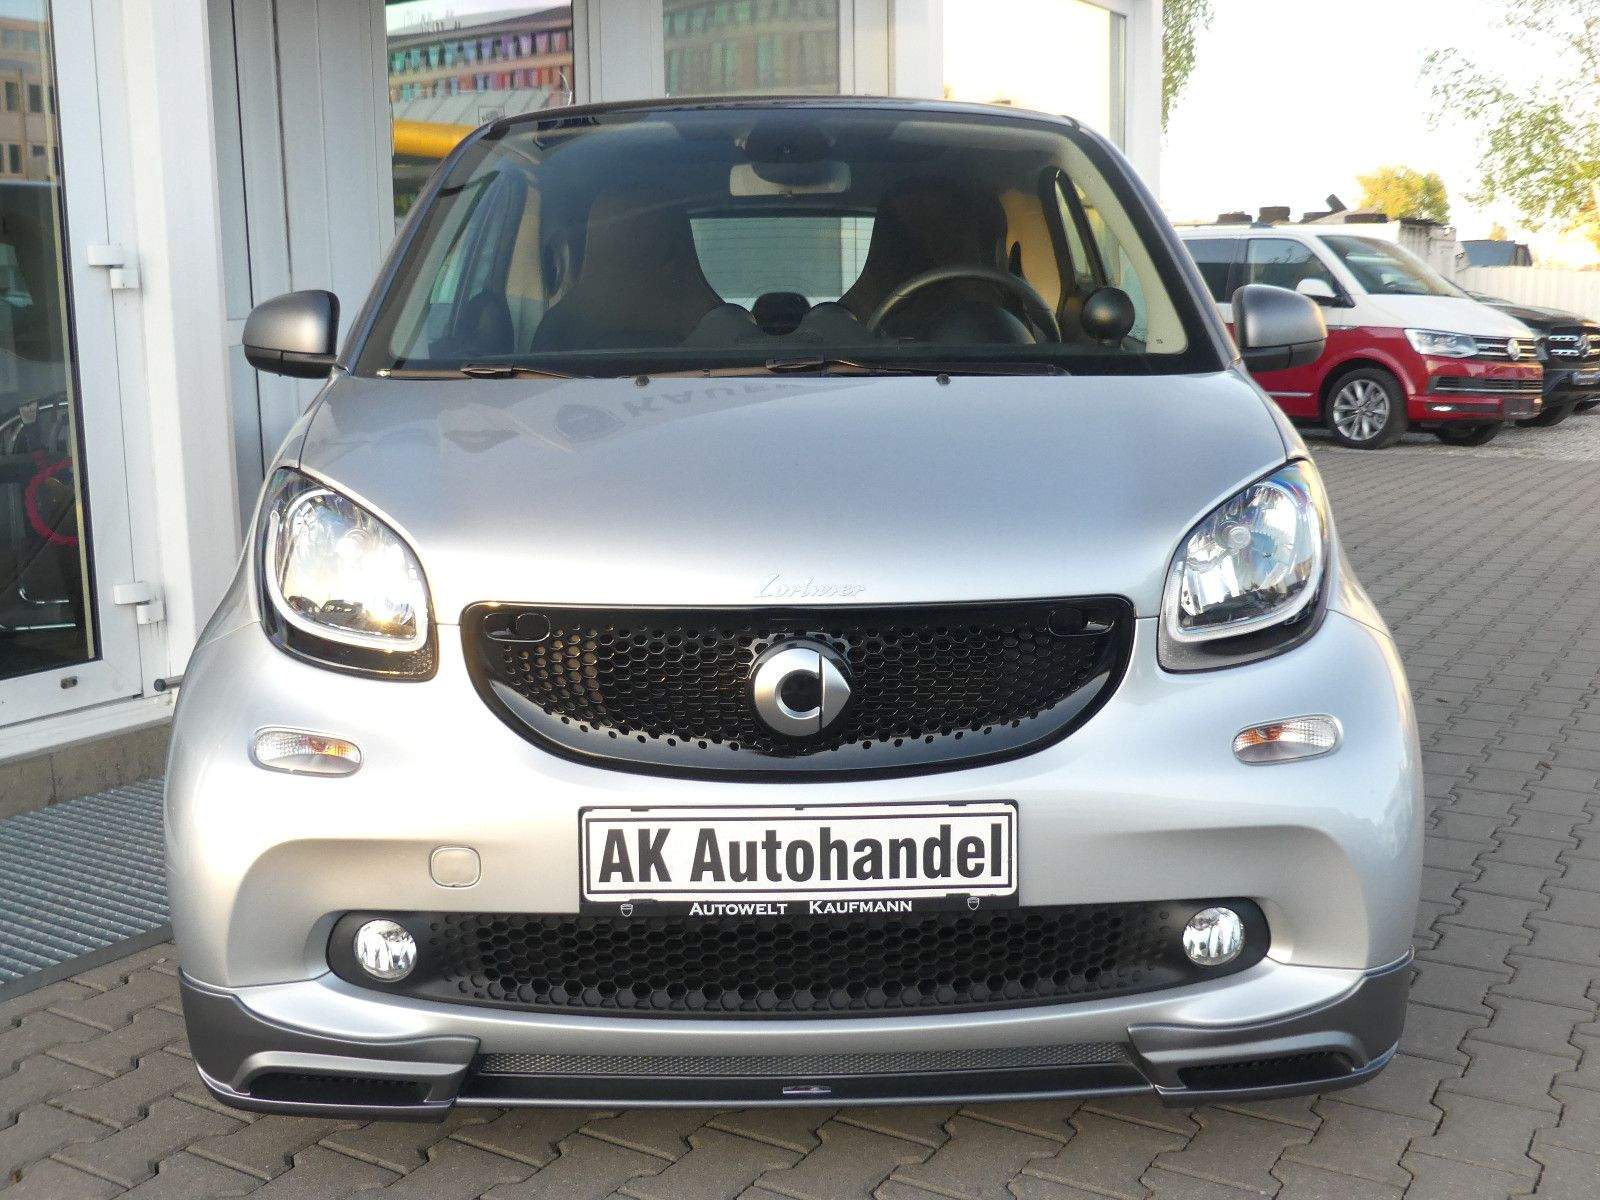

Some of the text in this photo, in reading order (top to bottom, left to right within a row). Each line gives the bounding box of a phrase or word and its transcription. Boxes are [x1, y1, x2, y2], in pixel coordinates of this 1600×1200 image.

[599, 823, 1002, 883] AK Autohandel
[688, 900, 913, 917] AUTOWELT KAUFMANN
